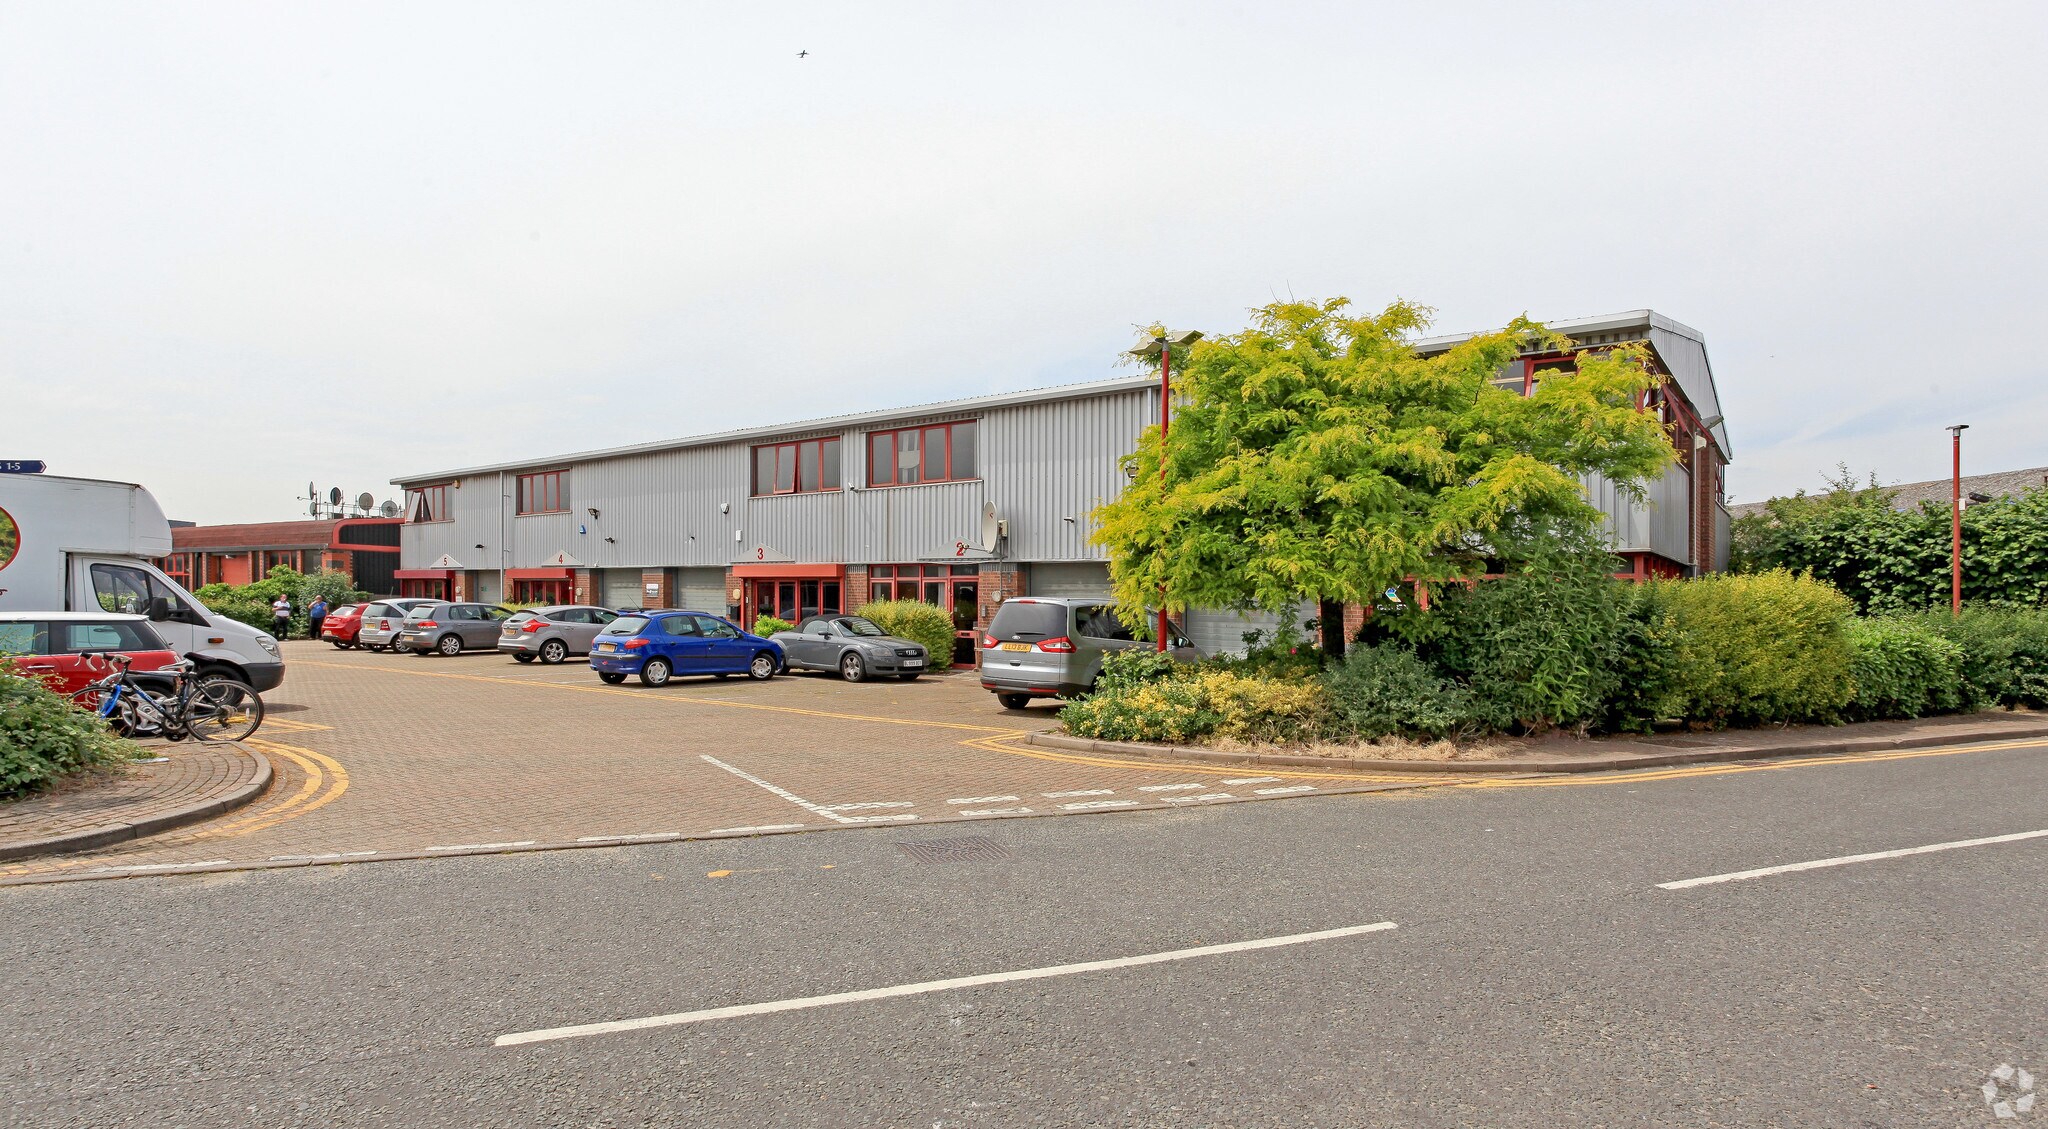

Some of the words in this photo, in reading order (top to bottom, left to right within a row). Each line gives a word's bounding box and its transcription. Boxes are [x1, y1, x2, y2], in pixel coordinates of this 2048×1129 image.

[6, 462, 21, 471] 1-5
[757, 547, 764, 560] 3
[956, 542, 964, 556] 2
[443, 557, 448, 567] 5
[558, 554, 563, 564] 4
